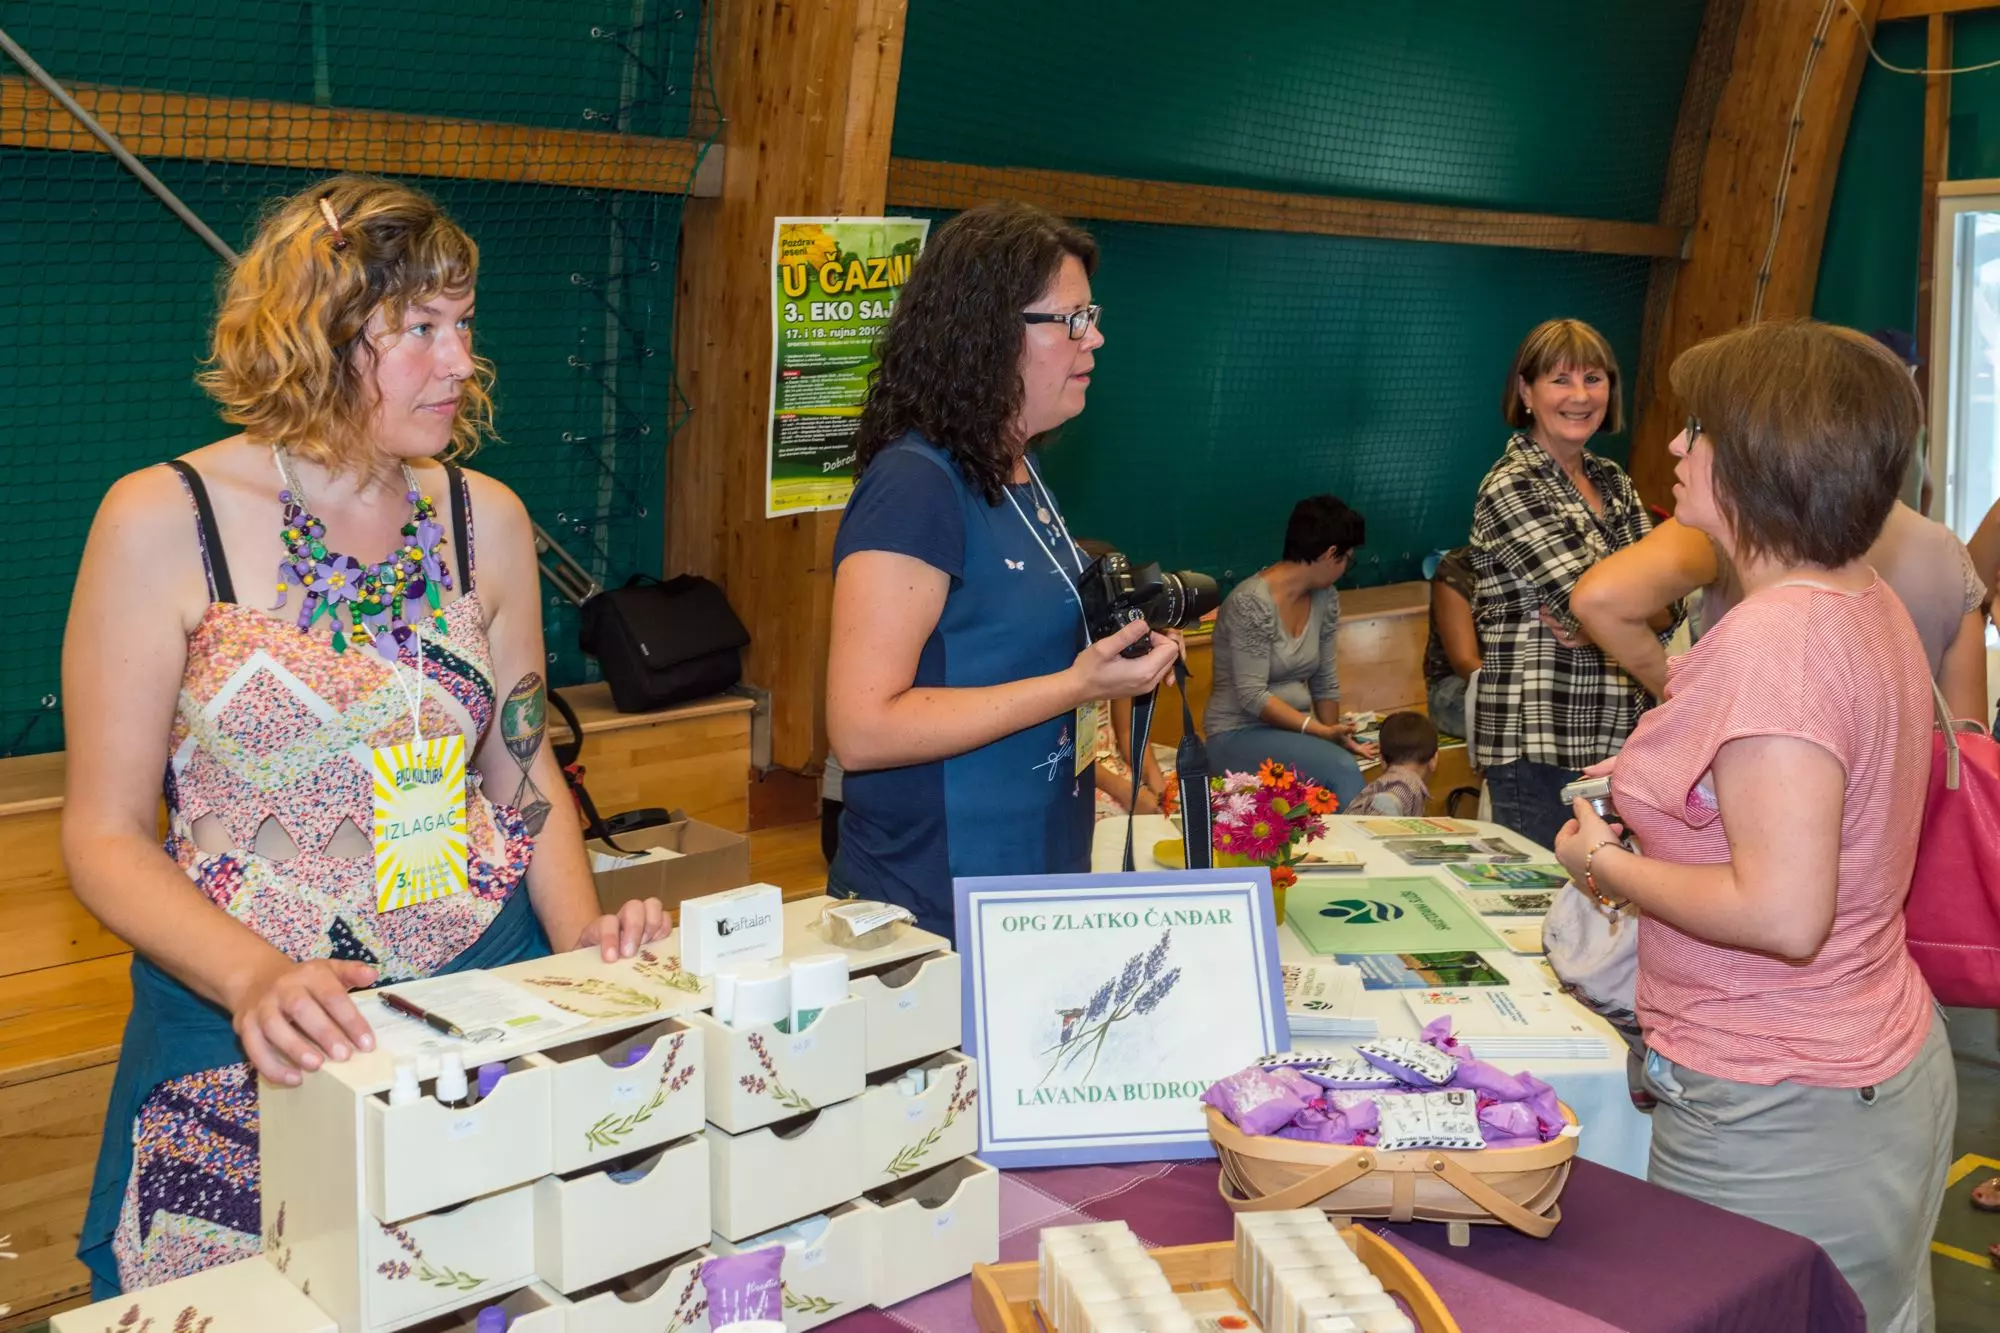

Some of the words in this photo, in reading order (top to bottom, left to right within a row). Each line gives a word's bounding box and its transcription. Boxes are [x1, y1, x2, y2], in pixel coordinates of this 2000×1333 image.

[782, 238, 815, 248] Pozdrav
[782, 247, 808, 257] jeseni
[782, 263, 807, 297] U
[784, 303, 804, 322] 3.
[810, 301, 854, 321] EKO
[785, 329, 802, 339] 17.
[804, 328, 809, 338] i
[812, 328, 827, 338] 18.
[830, 327, 856, 339] rujna
[413, 768, 444, 785] KULTURA
[384, 806, 457, 841] IZLAGAČ
[396, 873, 411, 889] 3.
[1002, 915, 1046, 933] OPG
[1052, 911, 1139, 932] ZLATKO
[1016, 1085, 1117, 1106] LAVANDA
[1123, 1080, 1217, 1101] BUDROV
